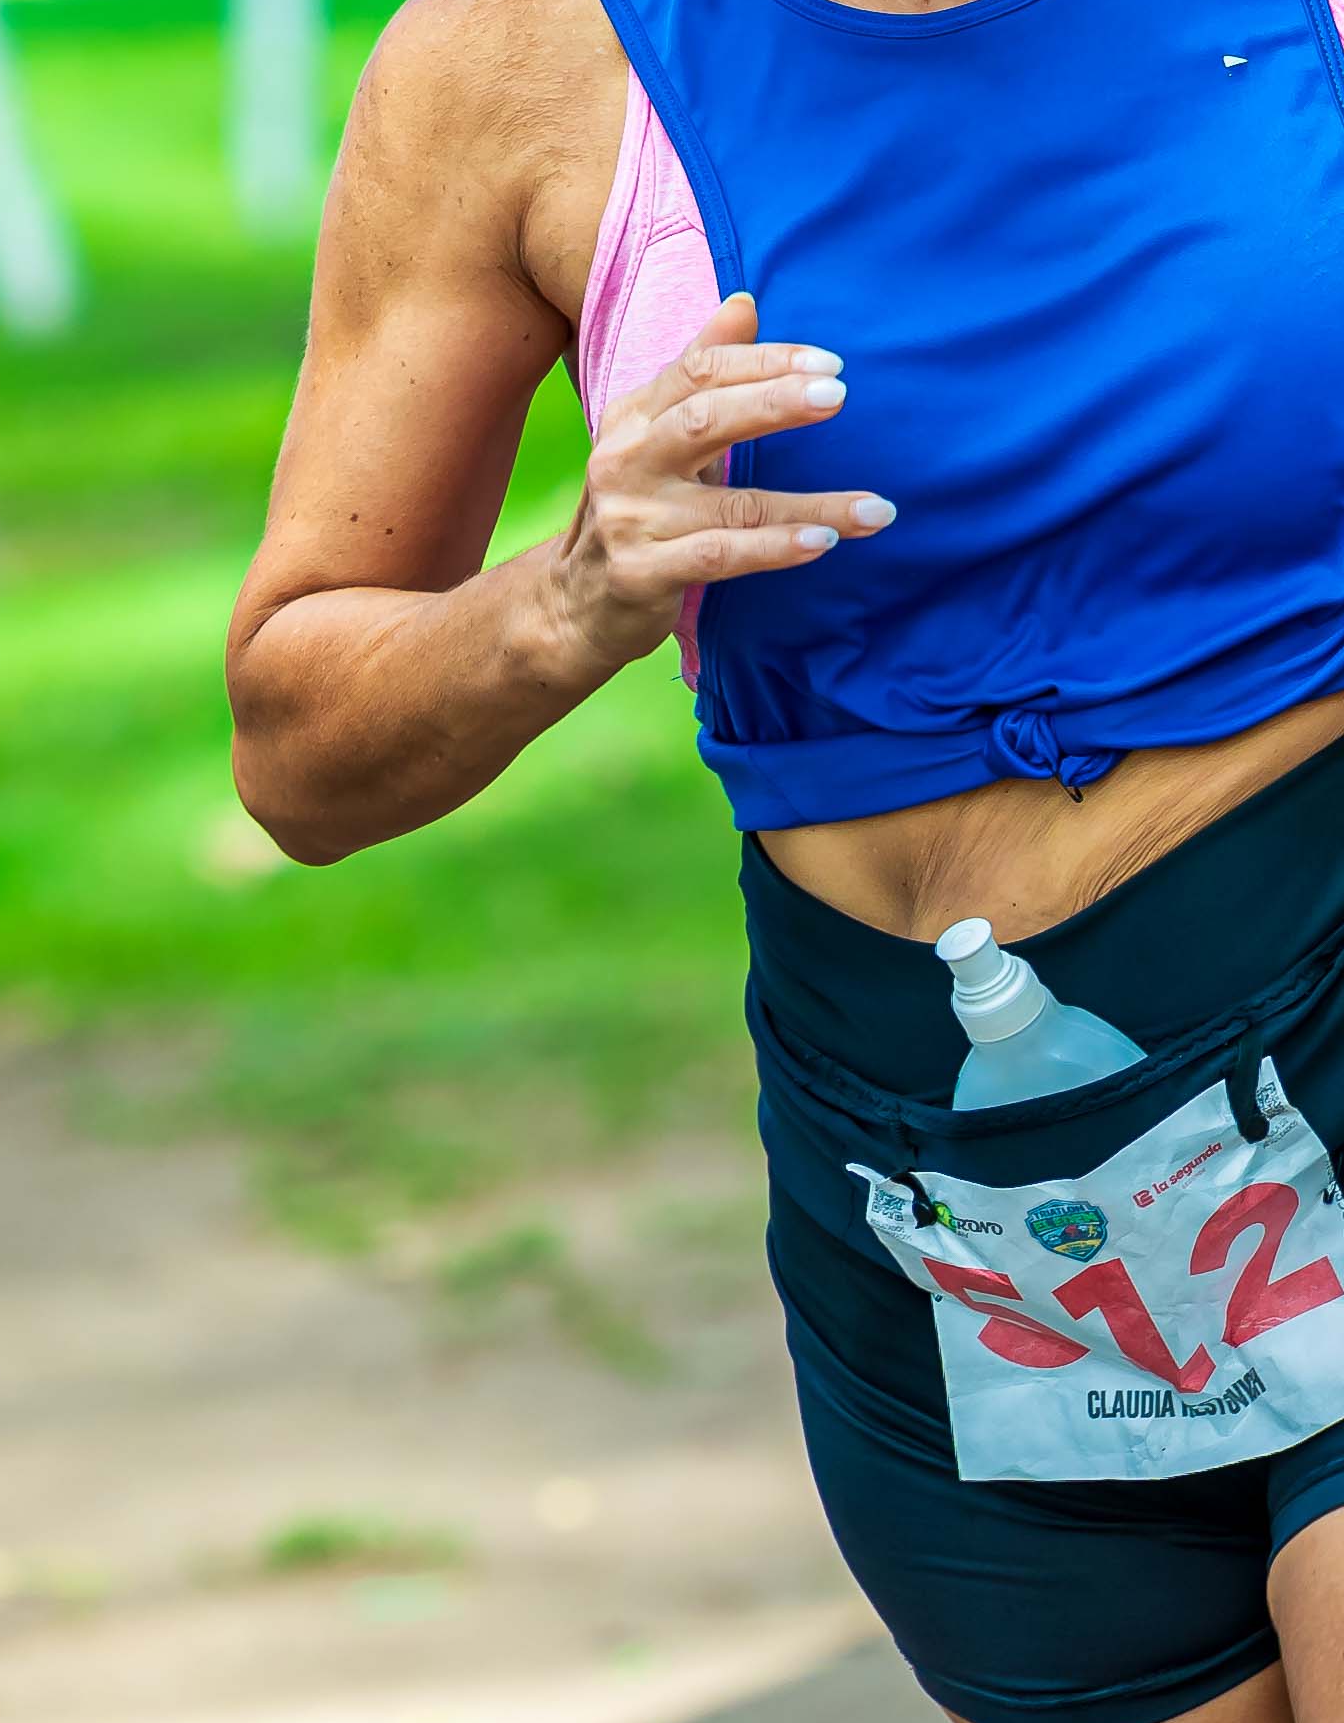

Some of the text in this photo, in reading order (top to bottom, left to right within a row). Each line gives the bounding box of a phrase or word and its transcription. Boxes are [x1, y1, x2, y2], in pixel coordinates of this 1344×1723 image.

[1151, 1180, 1170, 1194] la
[1169, 1142, 1223, 1185] segunda
[921, 1182, 1344, 1394] 512
[1087, 1390, 1176, 1419] CLAUDIA
